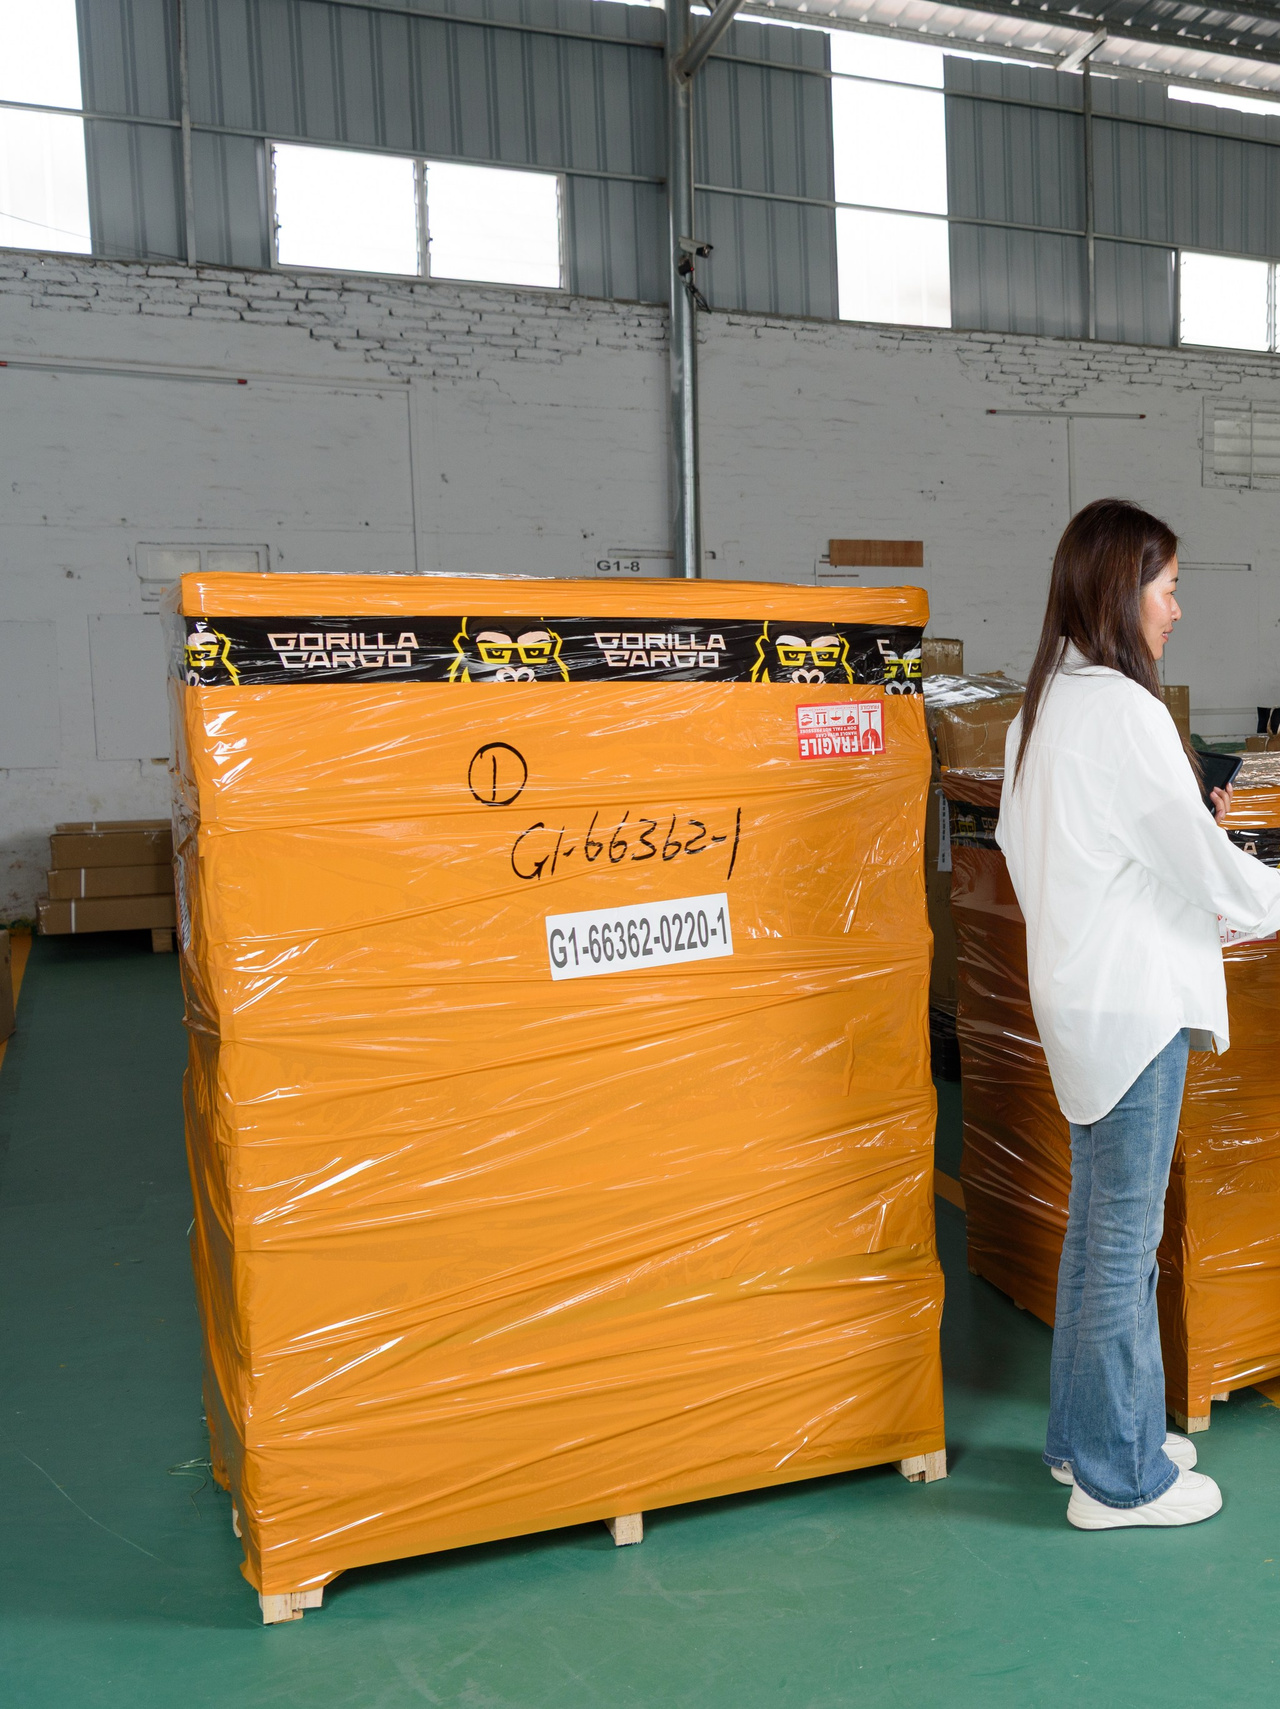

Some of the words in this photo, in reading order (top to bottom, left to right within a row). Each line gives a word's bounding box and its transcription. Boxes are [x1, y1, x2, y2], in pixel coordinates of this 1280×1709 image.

[597, 560, 640, 572] G1-8
[268, 632, 419, 651] GORILLA
[594, 632, 726, 651] GORILLA
[279, 651, 412, 668] CARGO
[605, 651, 719, 668] CARGO
[800, 736, 859, 756] FRAGILE
[549, 908, 728, 970] G1-66362-0220-1
